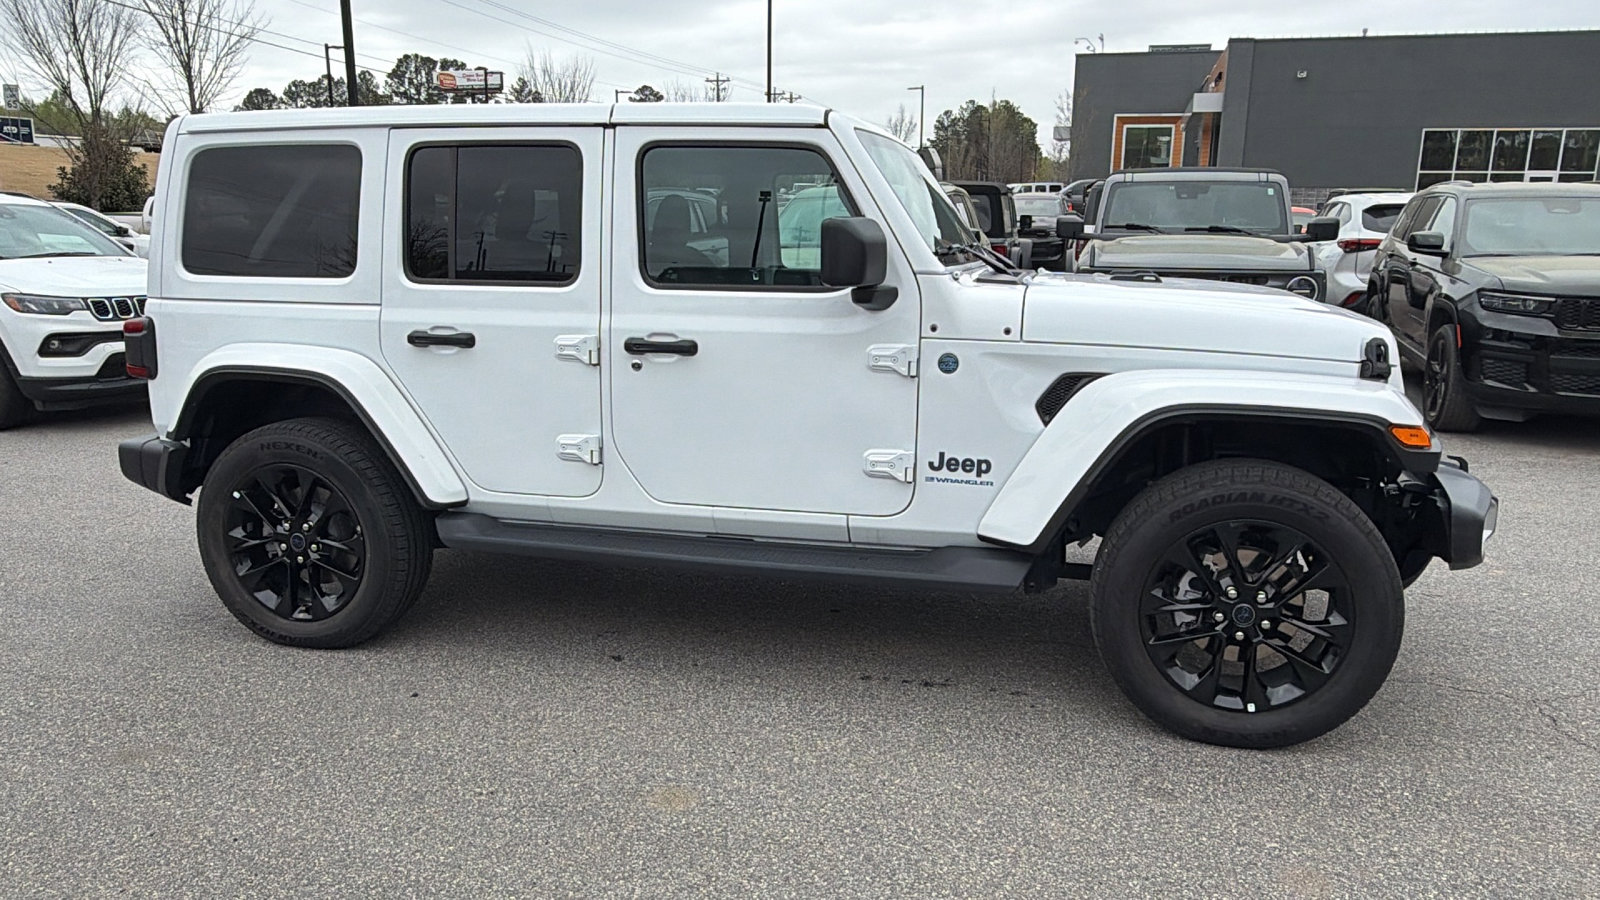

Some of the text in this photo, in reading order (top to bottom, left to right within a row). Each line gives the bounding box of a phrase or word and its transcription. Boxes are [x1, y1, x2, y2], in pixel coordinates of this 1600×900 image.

[7, 100, 18, 108] 65
[260, 441, 318, 458] NEXEN
[928, 451, 992, 478] Jeep
[936, 477, 994, 486] WRANGLER
[1168, 491, 1265, 521] ROADIAN
